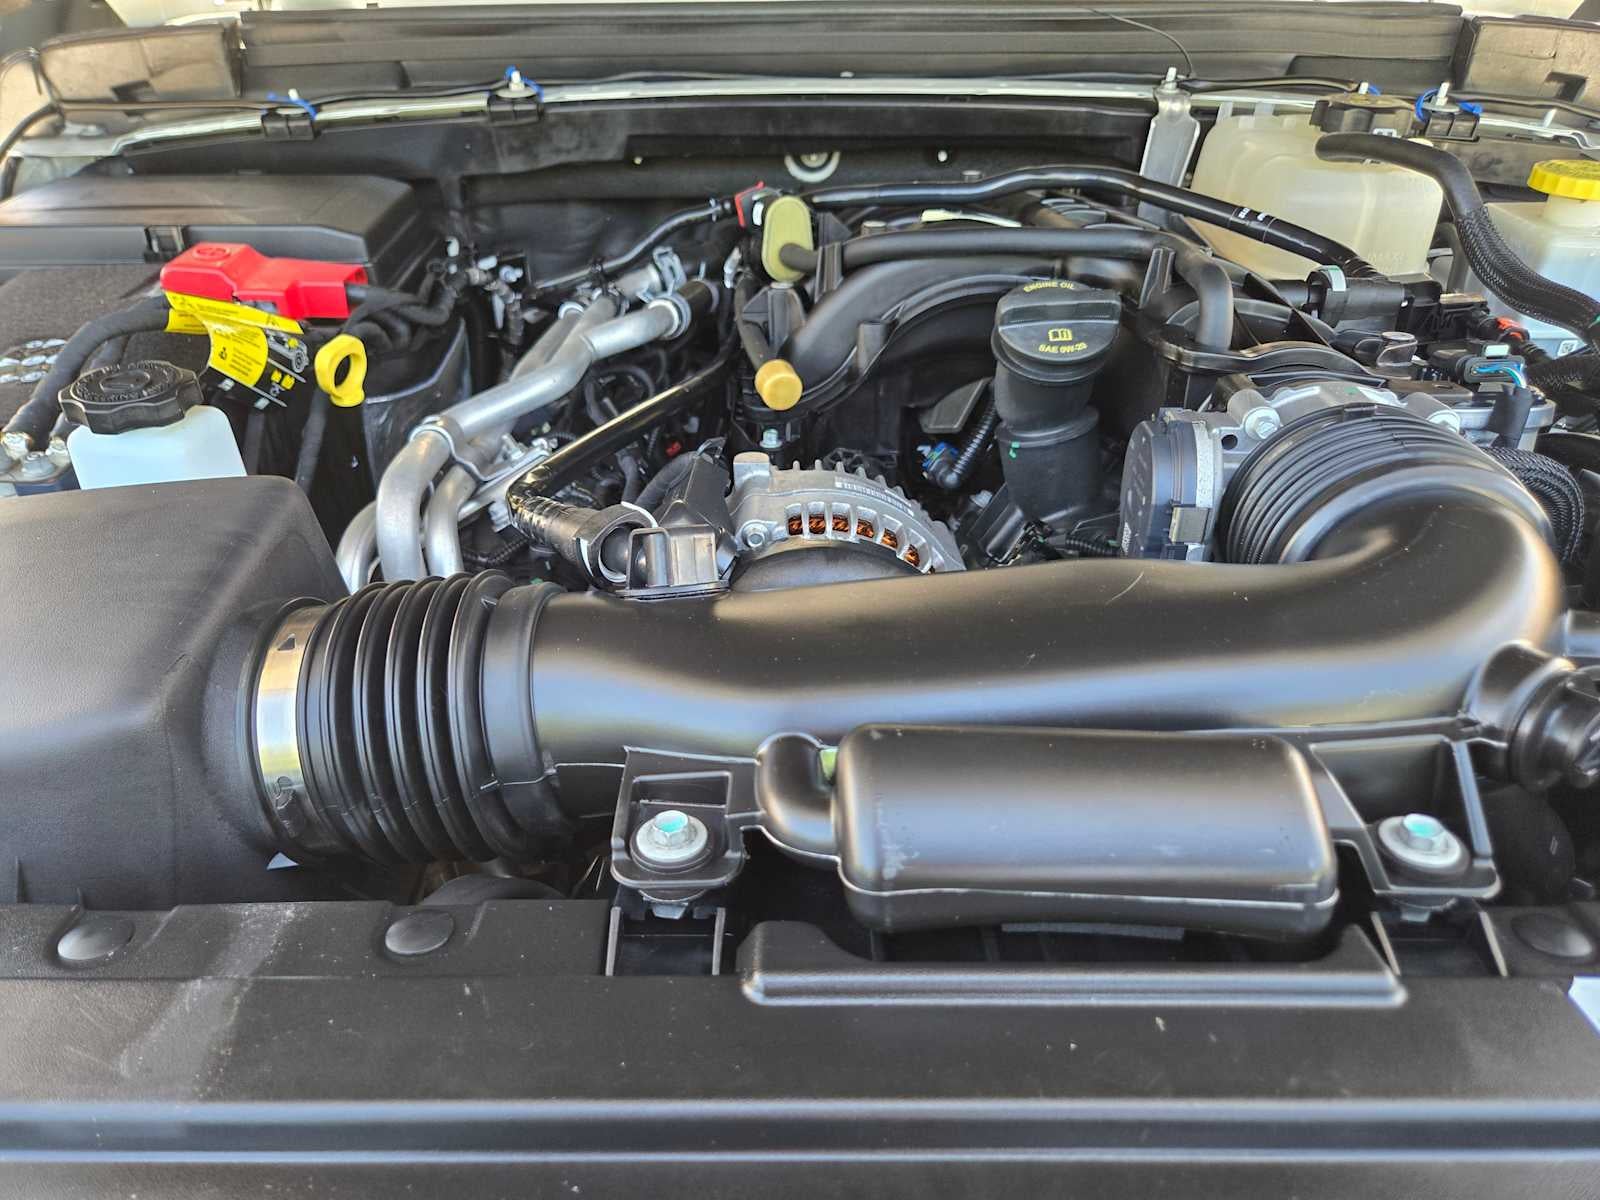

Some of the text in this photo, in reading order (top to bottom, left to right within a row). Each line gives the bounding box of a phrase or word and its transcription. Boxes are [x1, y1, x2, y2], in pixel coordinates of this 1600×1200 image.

[1023, 280, 1075, 293] ENGINE OIL
[1038, 344, 1059, 354] SAE
